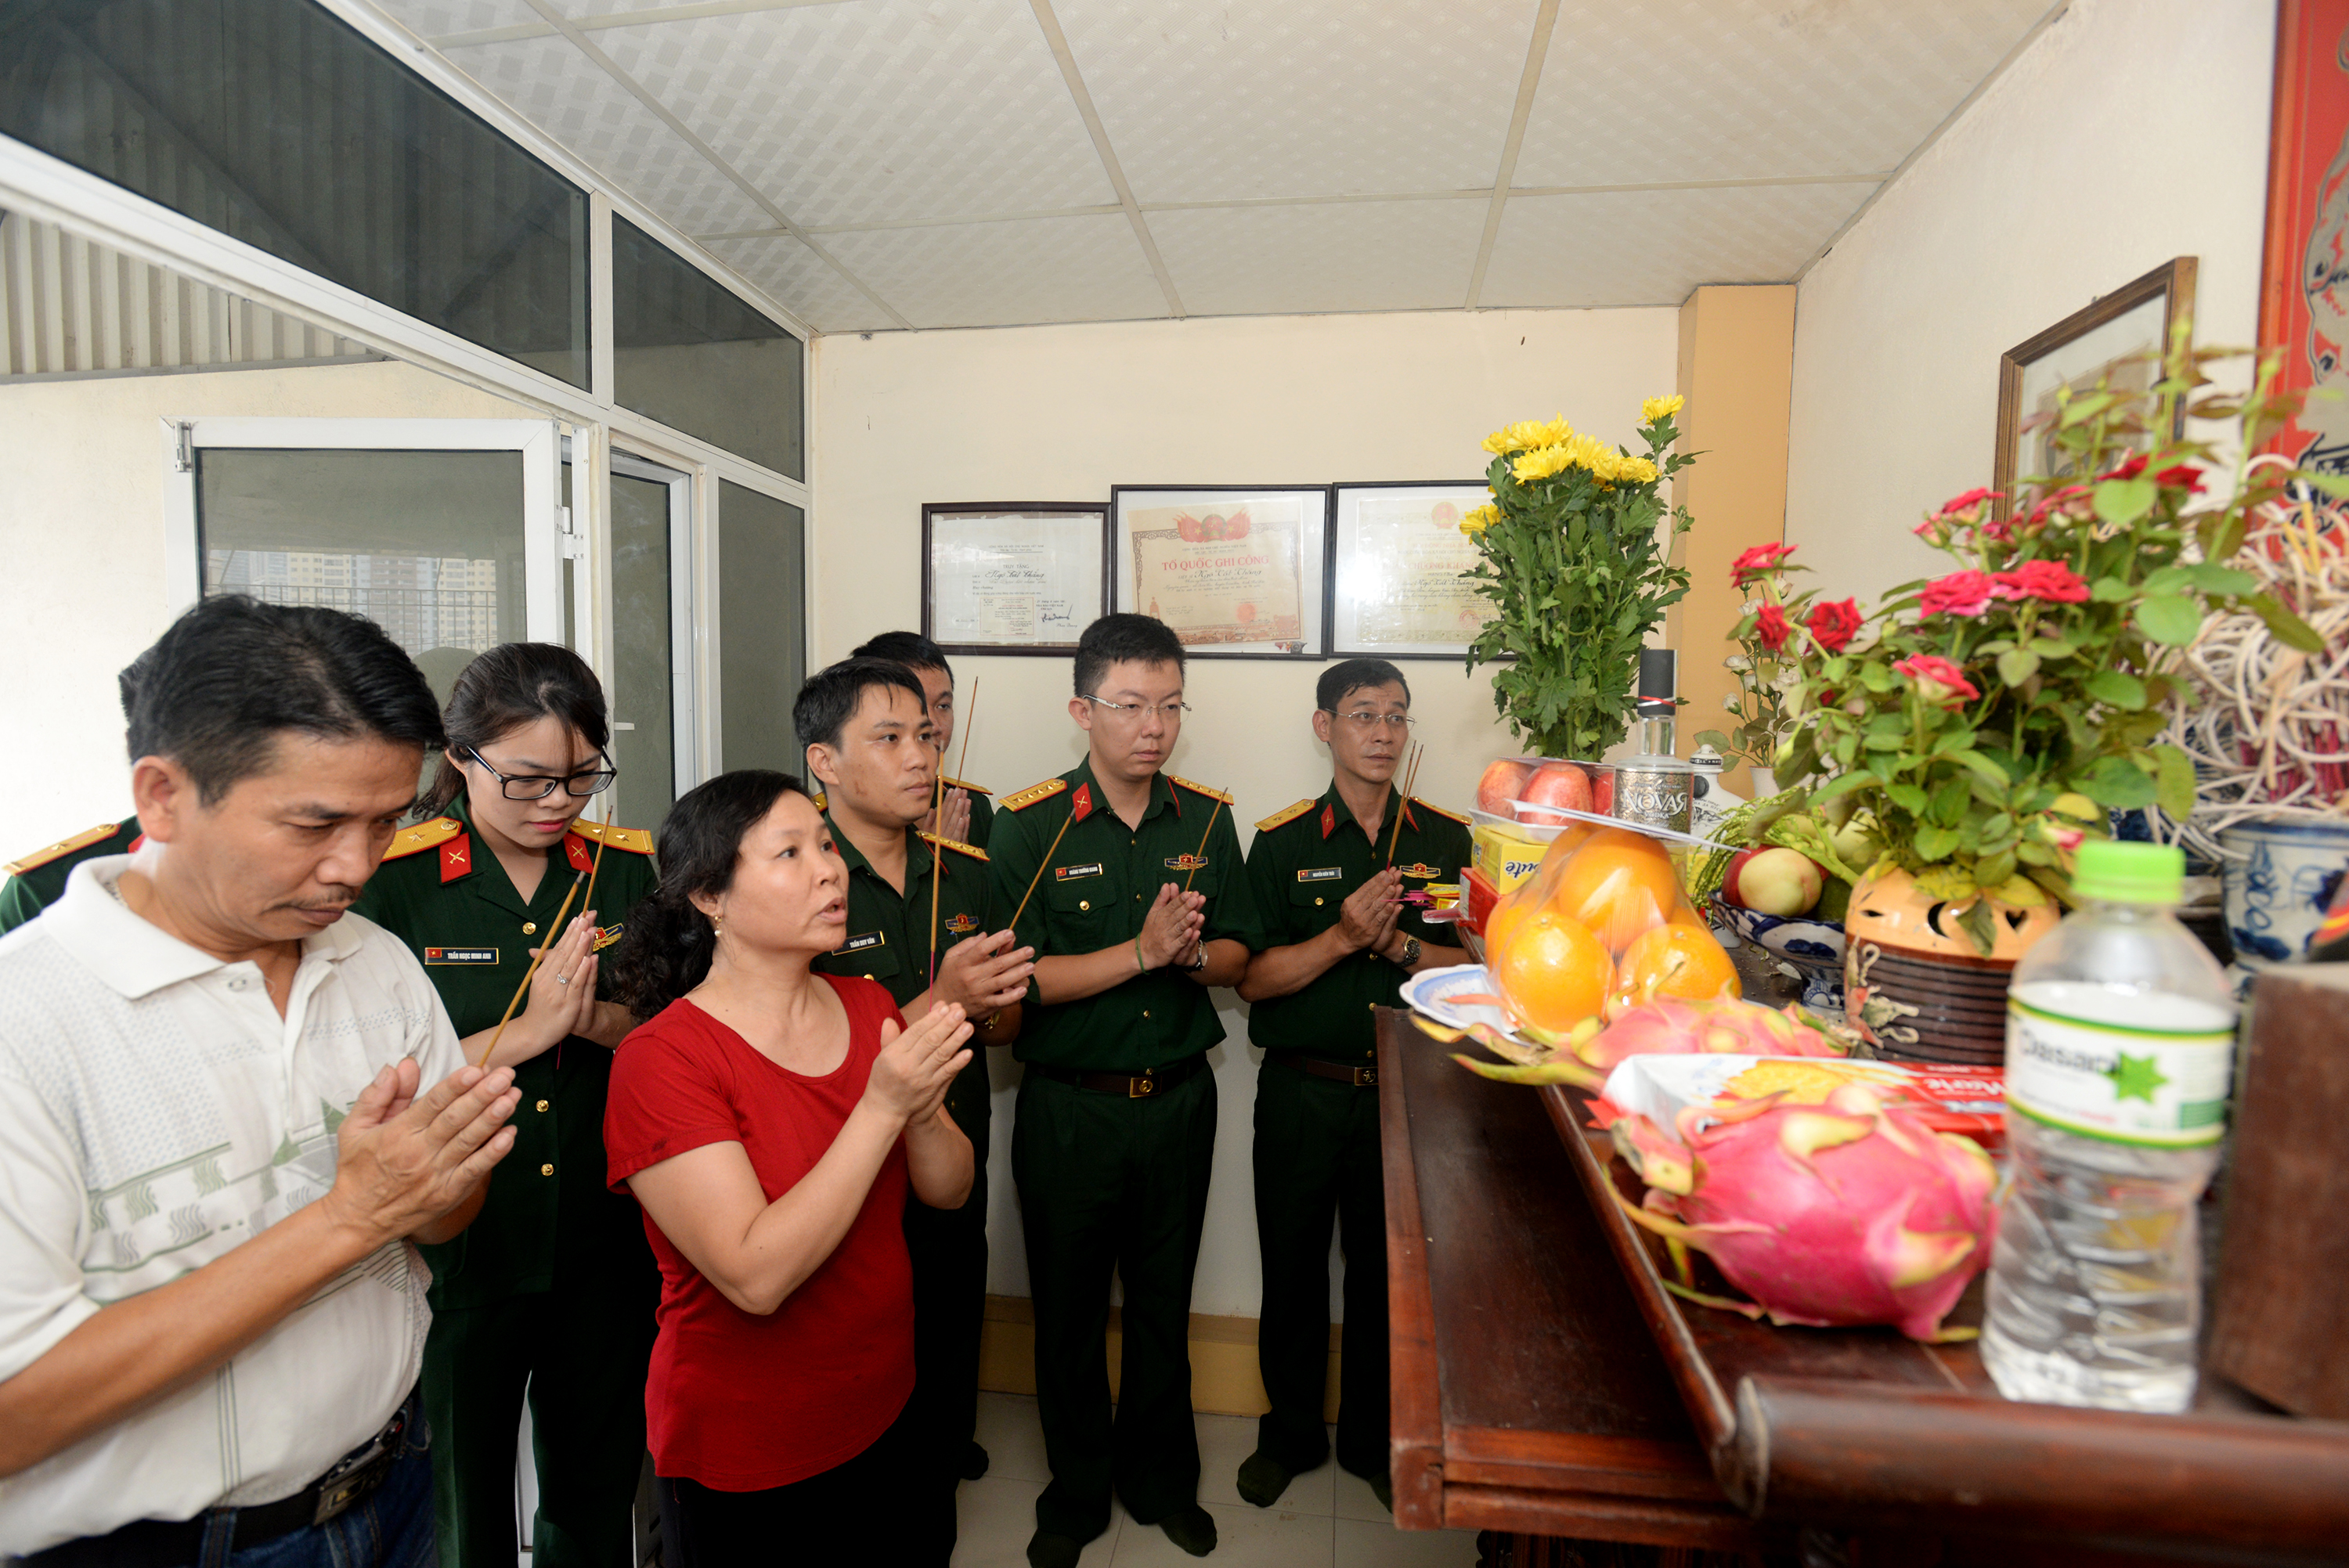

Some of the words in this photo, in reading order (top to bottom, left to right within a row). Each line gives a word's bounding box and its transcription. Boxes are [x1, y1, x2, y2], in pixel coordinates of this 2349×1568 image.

[1161, 559, 1178, 571] TỔ
[1180, 557, 1212, 571] QUỐC
[1215, 557, 1235, 568] GHI
[1238, 554, 1269, 565] CÔNG
